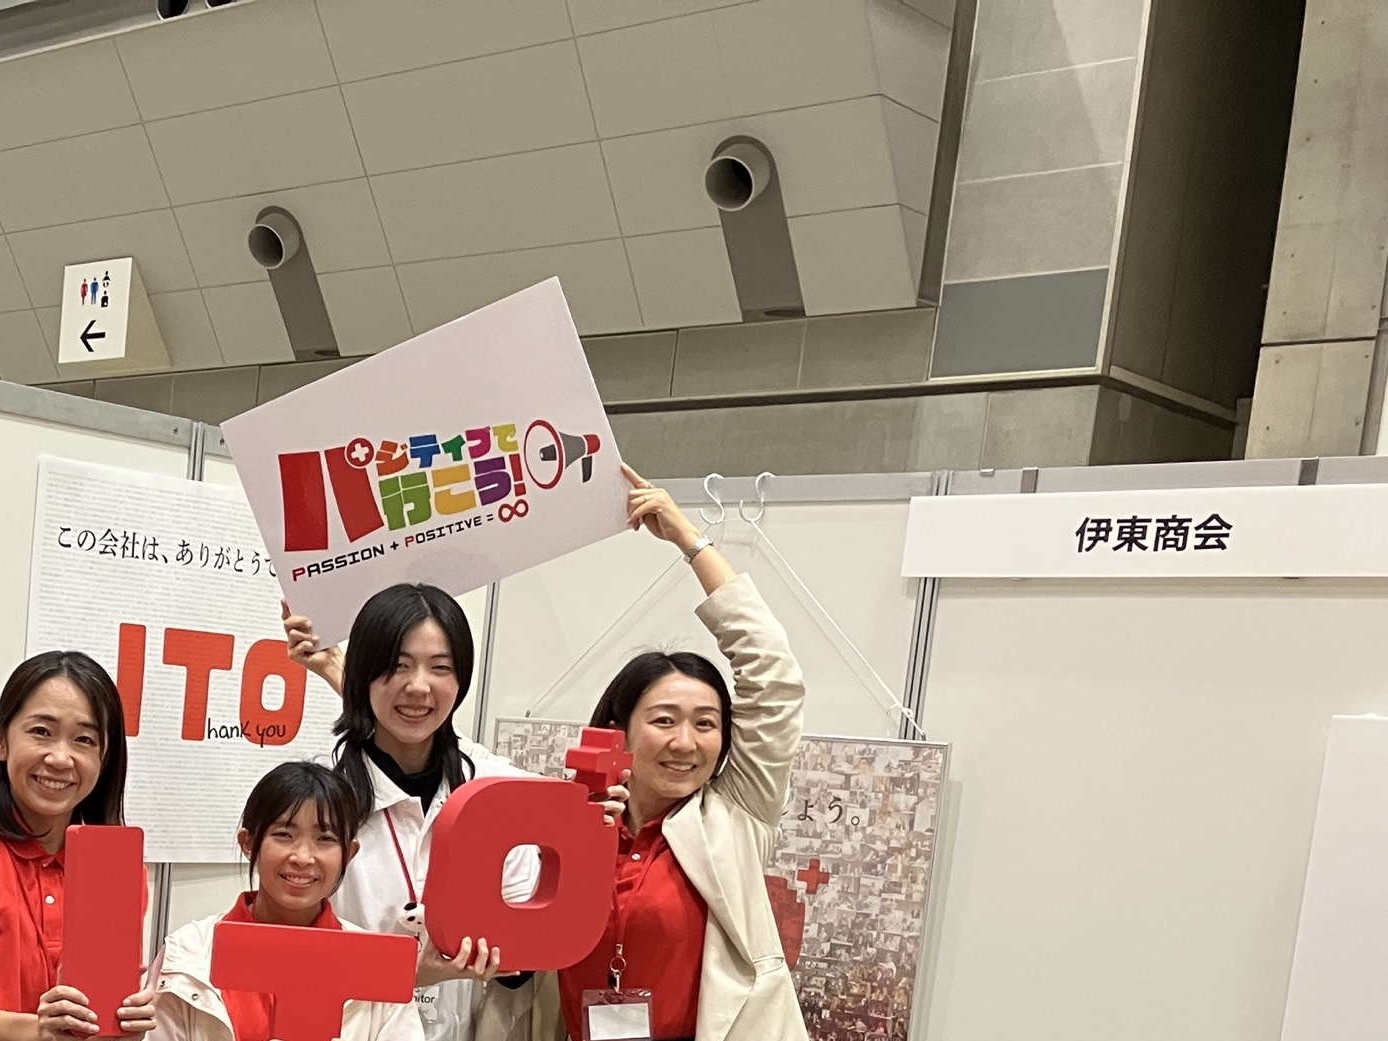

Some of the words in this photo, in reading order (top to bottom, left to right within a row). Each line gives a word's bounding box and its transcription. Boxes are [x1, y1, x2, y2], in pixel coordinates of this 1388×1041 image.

[292, 544, 386, 582] PASSION
[404, 515, 483, 548] POSITIVE
[1074, 513, 1234, 553] 伊東商会
[116, 622, 307, 746] ITO
[256, 721, 286, 749] you
